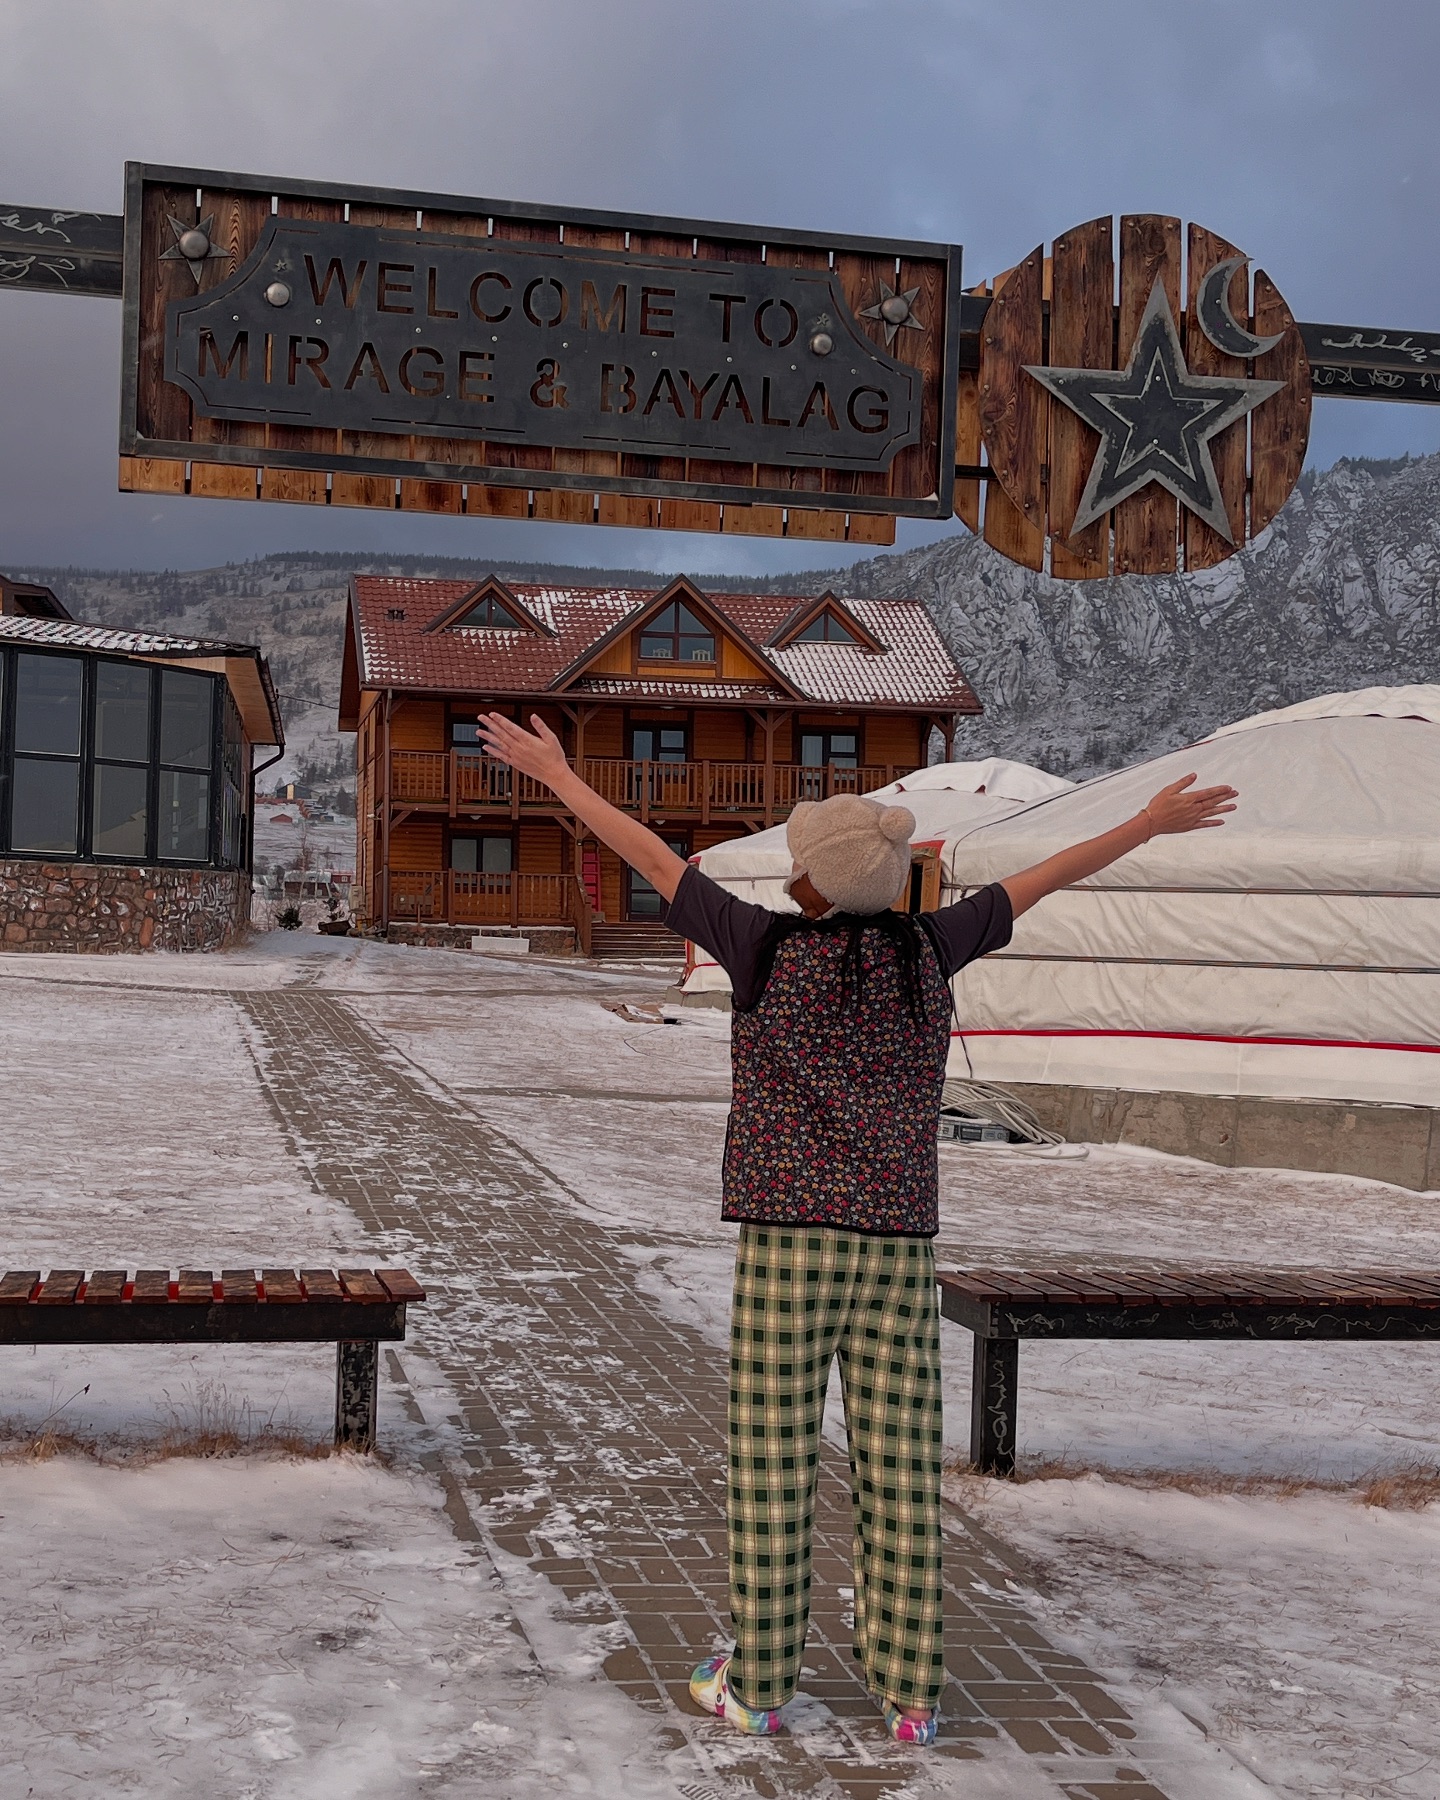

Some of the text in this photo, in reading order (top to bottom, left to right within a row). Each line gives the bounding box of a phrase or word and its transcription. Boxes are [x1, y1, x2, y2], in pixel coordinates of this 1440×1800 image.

[304, 254, 799, 348] WELCOME TO
[199, 326, 890, 434] MIRAGE & BAYALAG
